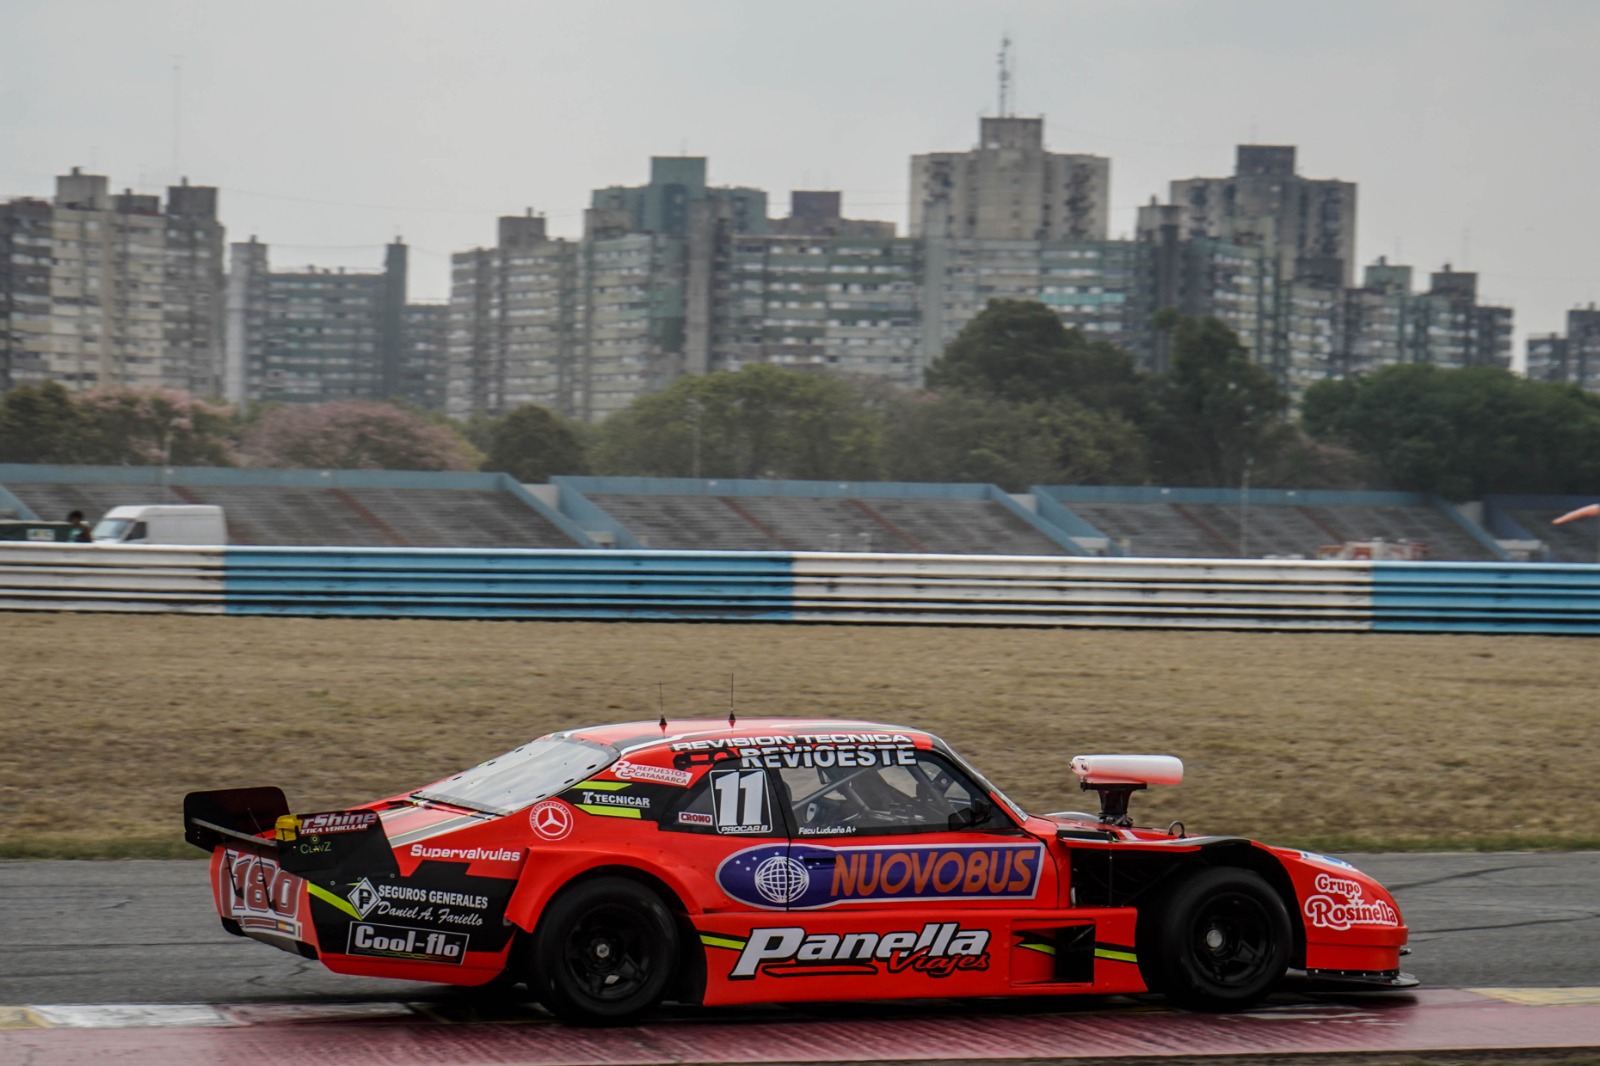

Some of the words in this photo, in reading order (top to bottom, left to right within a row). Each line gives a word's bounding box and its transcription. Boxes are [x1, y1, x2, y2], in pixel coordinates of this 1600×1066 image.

[673, 735, 796, 751] REVISION
[797, 734, 913, 744] TECNICA
[740, 744, 918, 768] REVIOESTE
[634, 771, 687, 784] CATAMARCA
[636, 765, 687, 778] REPUESTOS
[595, 794, 650, 806] TECNICAR
[715, 771, 764, 826] 11
[680, 812, 711, 823] CRONO
[325, 823, 368, 832] VEHICULAR
[721, 824, 757, 833] PROCAR
[798, 826, 816, 835] Facu
[410, 844, 521, 862] Supervalvulas
[830, 850, 1035, 897] NUOVOBUS
[1317, 876, 1360, 895] Grupo
[378, 884, 428, 902] SEGUROS
[428, 890, 489, 909] GENERALES
[377, 901, 419, 919] Daniel
[417, 907, 434, 920] A.
[438, 908, 483, 926] Fariello
[1307, 898, 1397, 928] Rosinella
[354, 925, 461, 957] Cool-flo
[731, 922, 989, 976] Panella
[889, 948, 989, 975] Viajes
